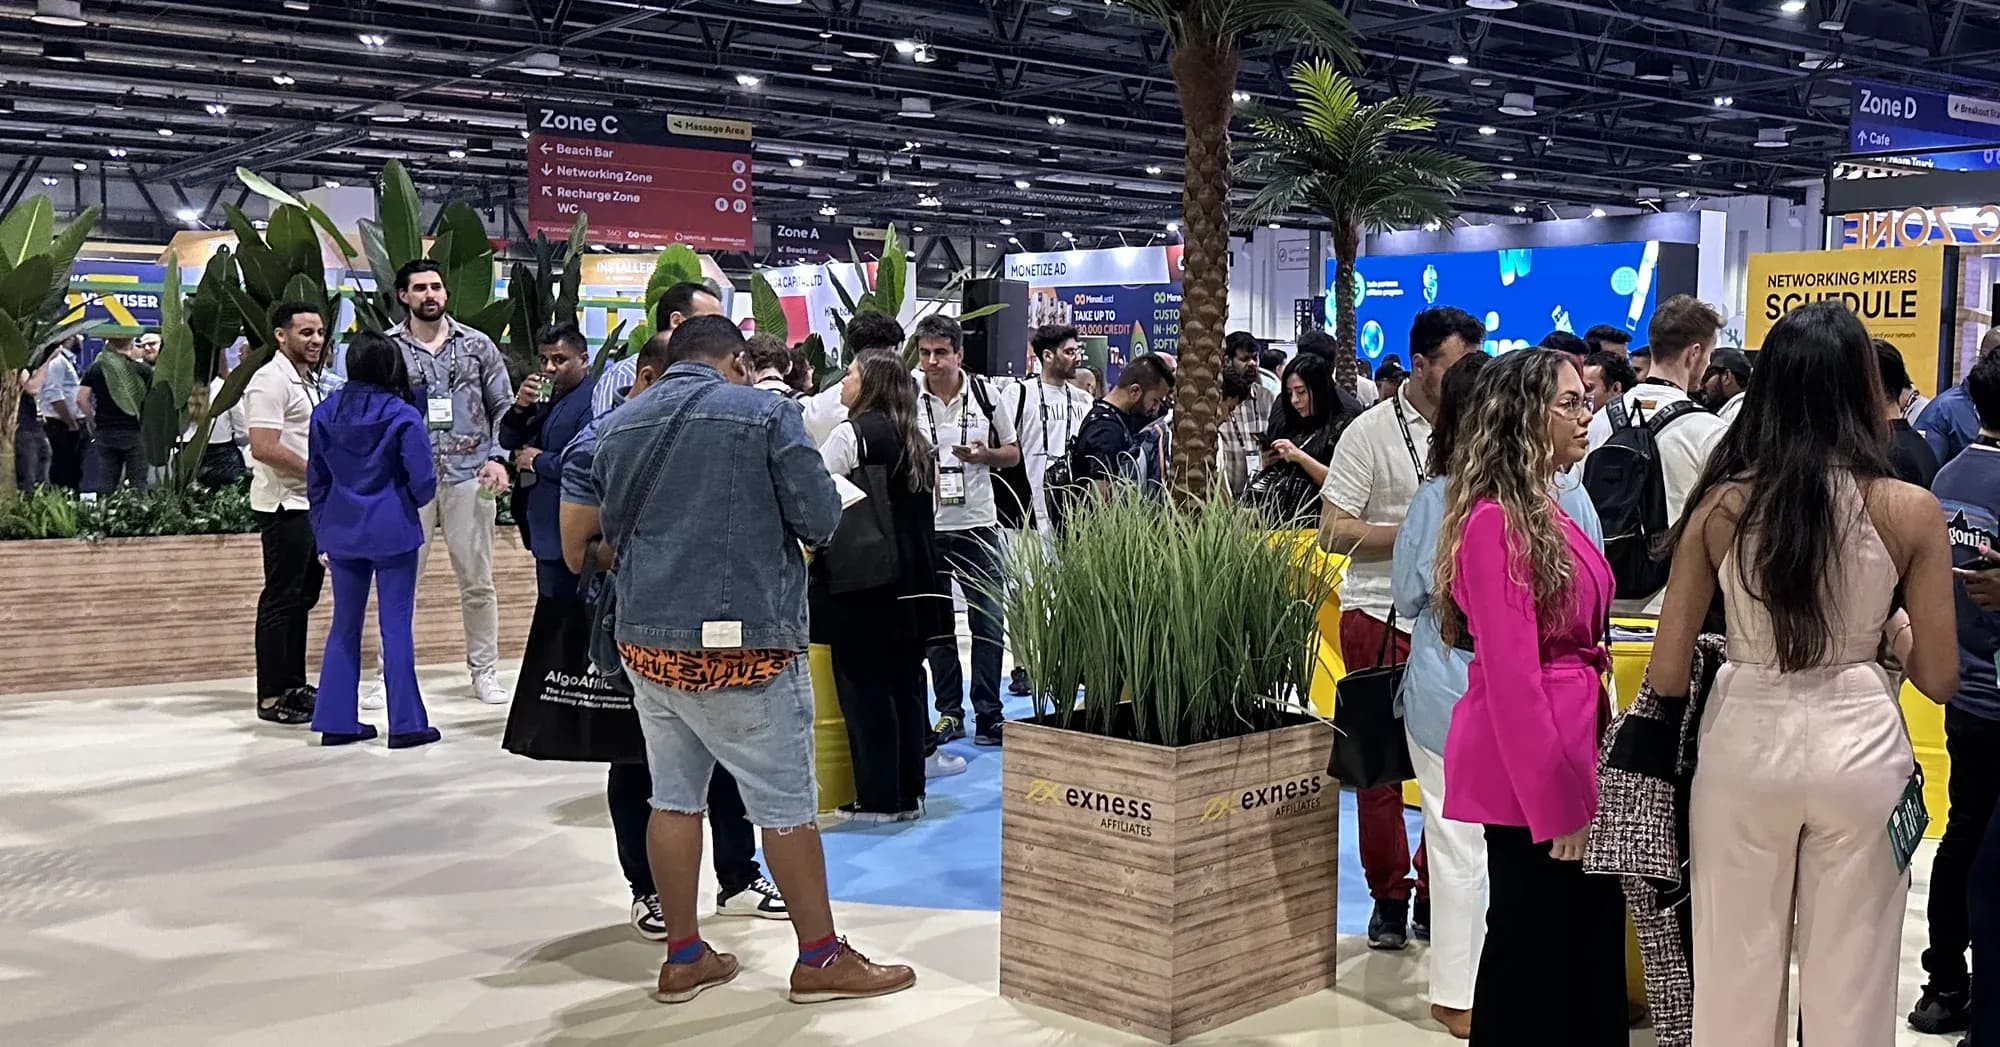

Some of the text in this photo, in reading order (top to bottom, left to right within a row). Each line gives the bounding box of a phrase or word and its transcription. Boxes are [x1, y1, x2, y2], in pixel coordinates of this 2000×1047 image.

[1859, 89, 1917, 119] Zone D
[1960, 103, 1989, 117] Breakout
[539, 108, 619, 134] Zone C
[685, 121, 745, 135] Massage Area
[1869, 131, 1890, 146] Cafe
[556, 143, 614, 158] Beach Bar
[556, 165, 652, 183] Networking Zone
[557, 186, 641, 203] Recharge Zone
[557, 202, 579, 215] WC
[777, 225, 820, 240] Zone A
[786, 245, 819, 255] Beach Bar
[596, 262, 654, 273] INSTALLER
[1011, 262, 1067, 277] MONETIZE AD
[1767, 269, 1917, 288] NETWORKING MIXERS
[1074, 310, 1116, 321] TAKE UP TO
[1153, 308, 1180, 320] CUSTO
[1103, 323, 1130, 335] CREDIT
[1948, 526, 1992, 548] gonia
[1241, 775, 1321, 810] exness
[1065, 786, 1152, 820] exness
[1274, 797, 1321, 818] AFFILIATES
[1100, 817, 1152, 838] AFFILIATES
